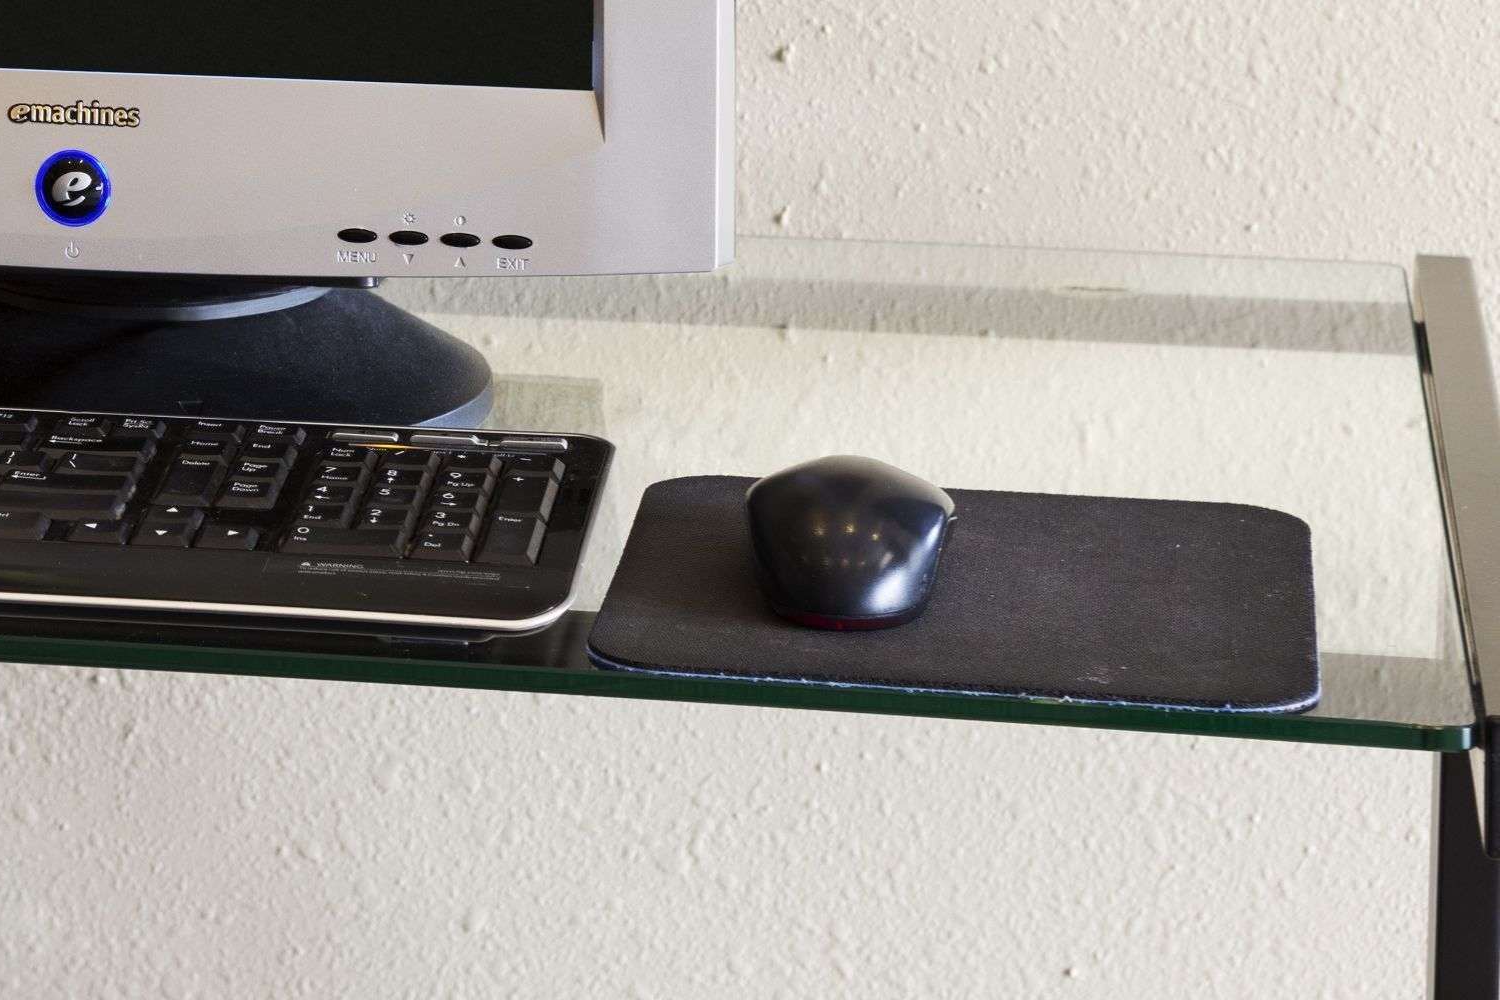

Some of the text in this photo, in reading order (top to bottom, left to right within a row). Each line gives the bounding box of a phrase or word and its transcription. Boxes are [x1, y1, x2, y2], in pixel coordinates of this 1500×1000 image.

[8, 100, 140, 127] emachines
[337, 252, 377, 263] MENU
[496, 257, 529, 270] EXIT
[387, 470, 397, 478] 8
